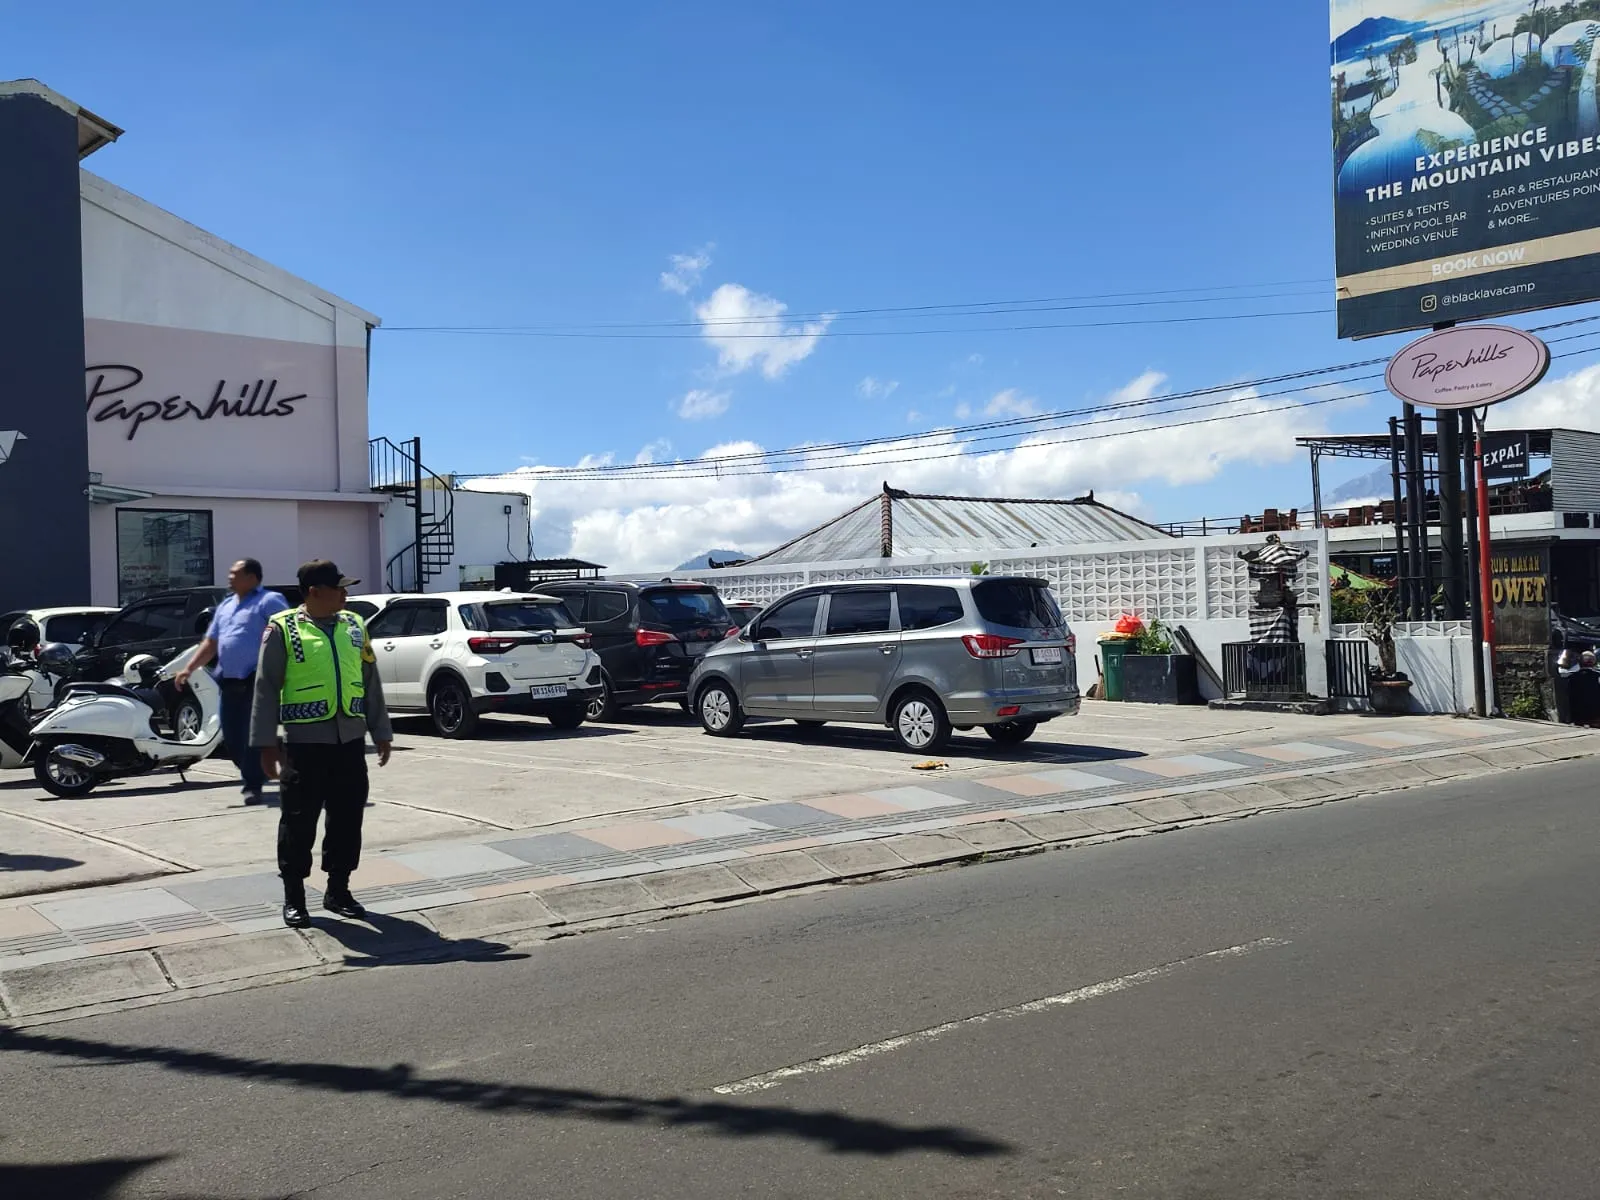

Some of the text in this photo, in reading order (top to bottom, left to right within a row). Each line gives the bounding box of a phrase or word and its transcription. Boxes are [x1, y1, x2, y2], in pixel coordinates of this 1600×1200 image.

[1415, 127, 1547, 172] EXPERIENCE
[1365, 181, 1402, 202] THE
[1411, 151, 1531, 193] MOUNTAIN
[1493, 168, 1600, 199] BAR & RESTAURAN
[1370, 201, 1450, 226] SUITES & TENTS
[1493, 189, 1570, 214] ADVENTURES
[1370, 211, 1467, 240] INFINITY POOL BAR
[1488, 220, 1495, 230] &
[1371, 228, 1459, 253] WEDDING VENUE
[1431, 248, 1525, 277] BOOK NOW
[1441, 281, 1536, 306] @blacklavacamp
[1411, 343, 1514, 382] Paperhills
[85, 364, 307, 441] Paperhills
[1483, 443, 1524, 467] EXPAT.
[1511, 556, 1540, 572] MAKAN
